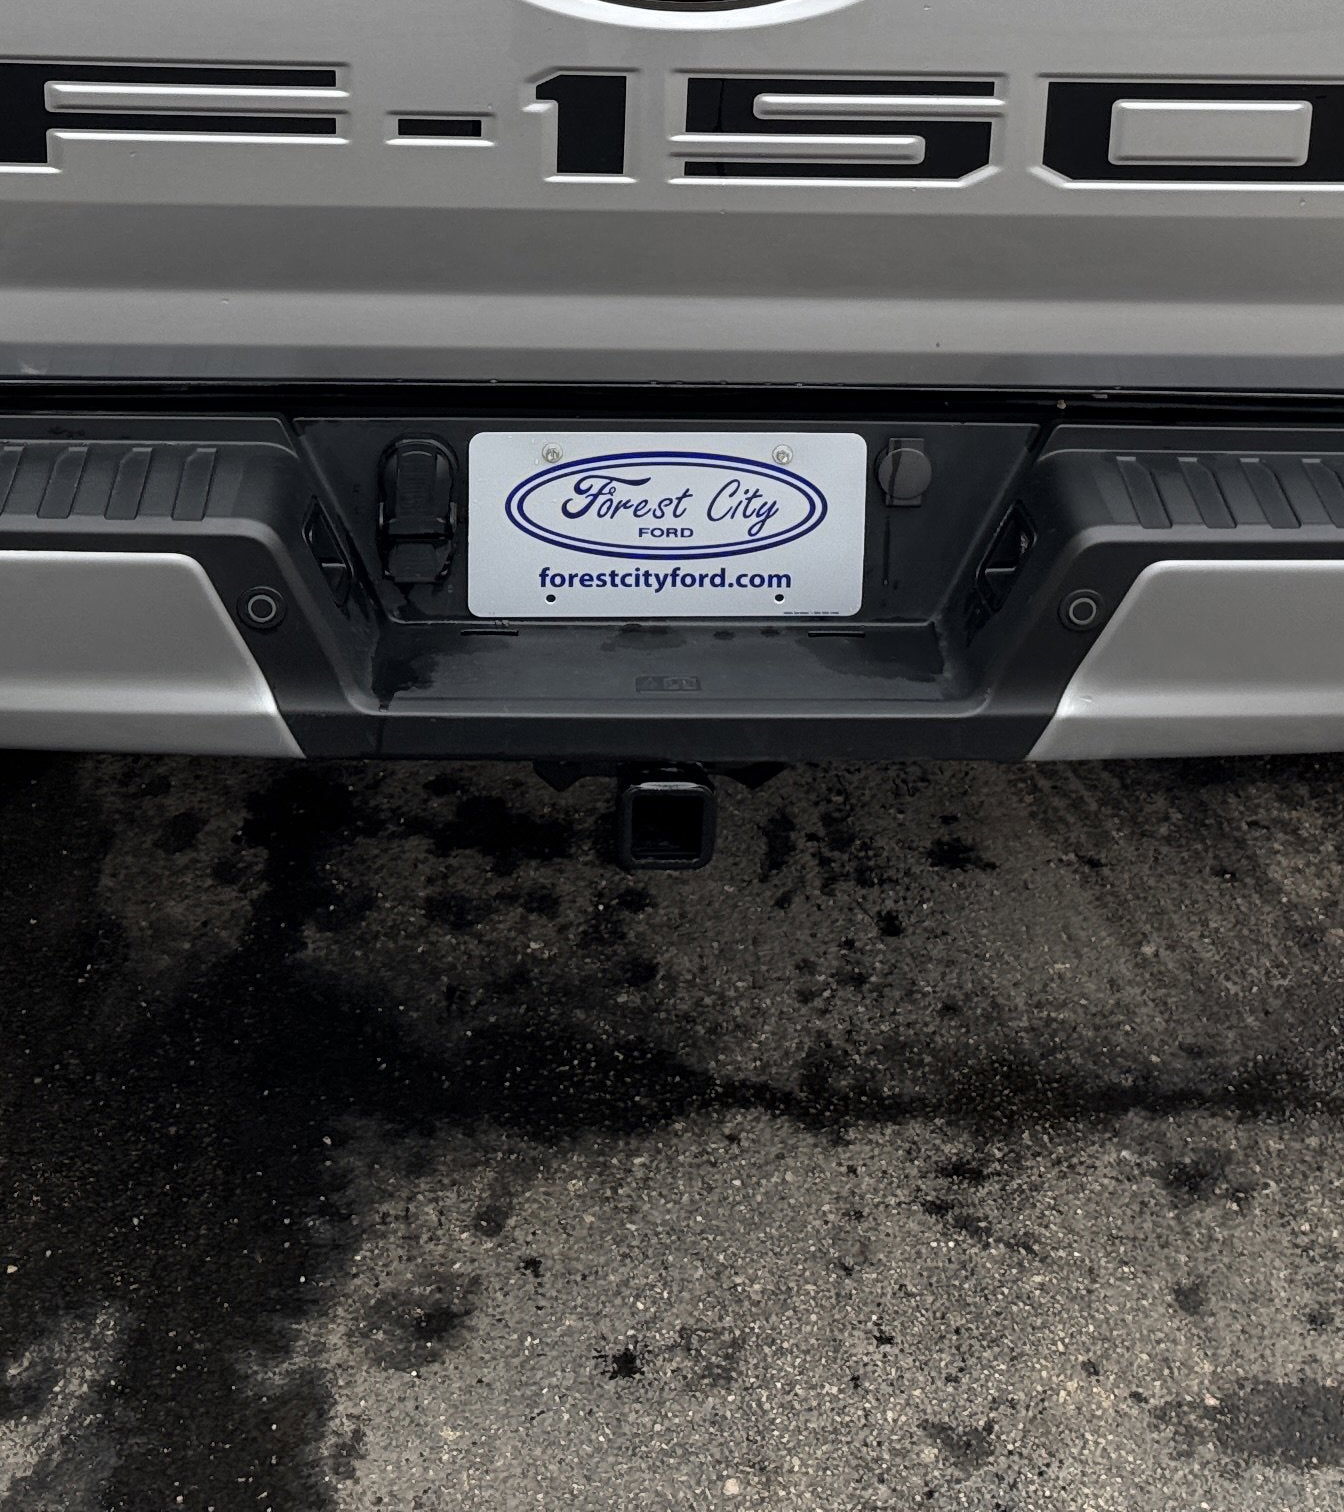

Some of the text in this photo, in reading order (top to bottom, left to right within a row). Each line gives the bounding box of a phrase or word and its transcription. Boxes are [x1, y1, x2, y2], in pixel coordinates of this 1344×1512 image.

[561, 474, 780, 538] Forest City
[638, 526, 695, 539] FORD
[539, 566, 792, 594] forestcityford.com
